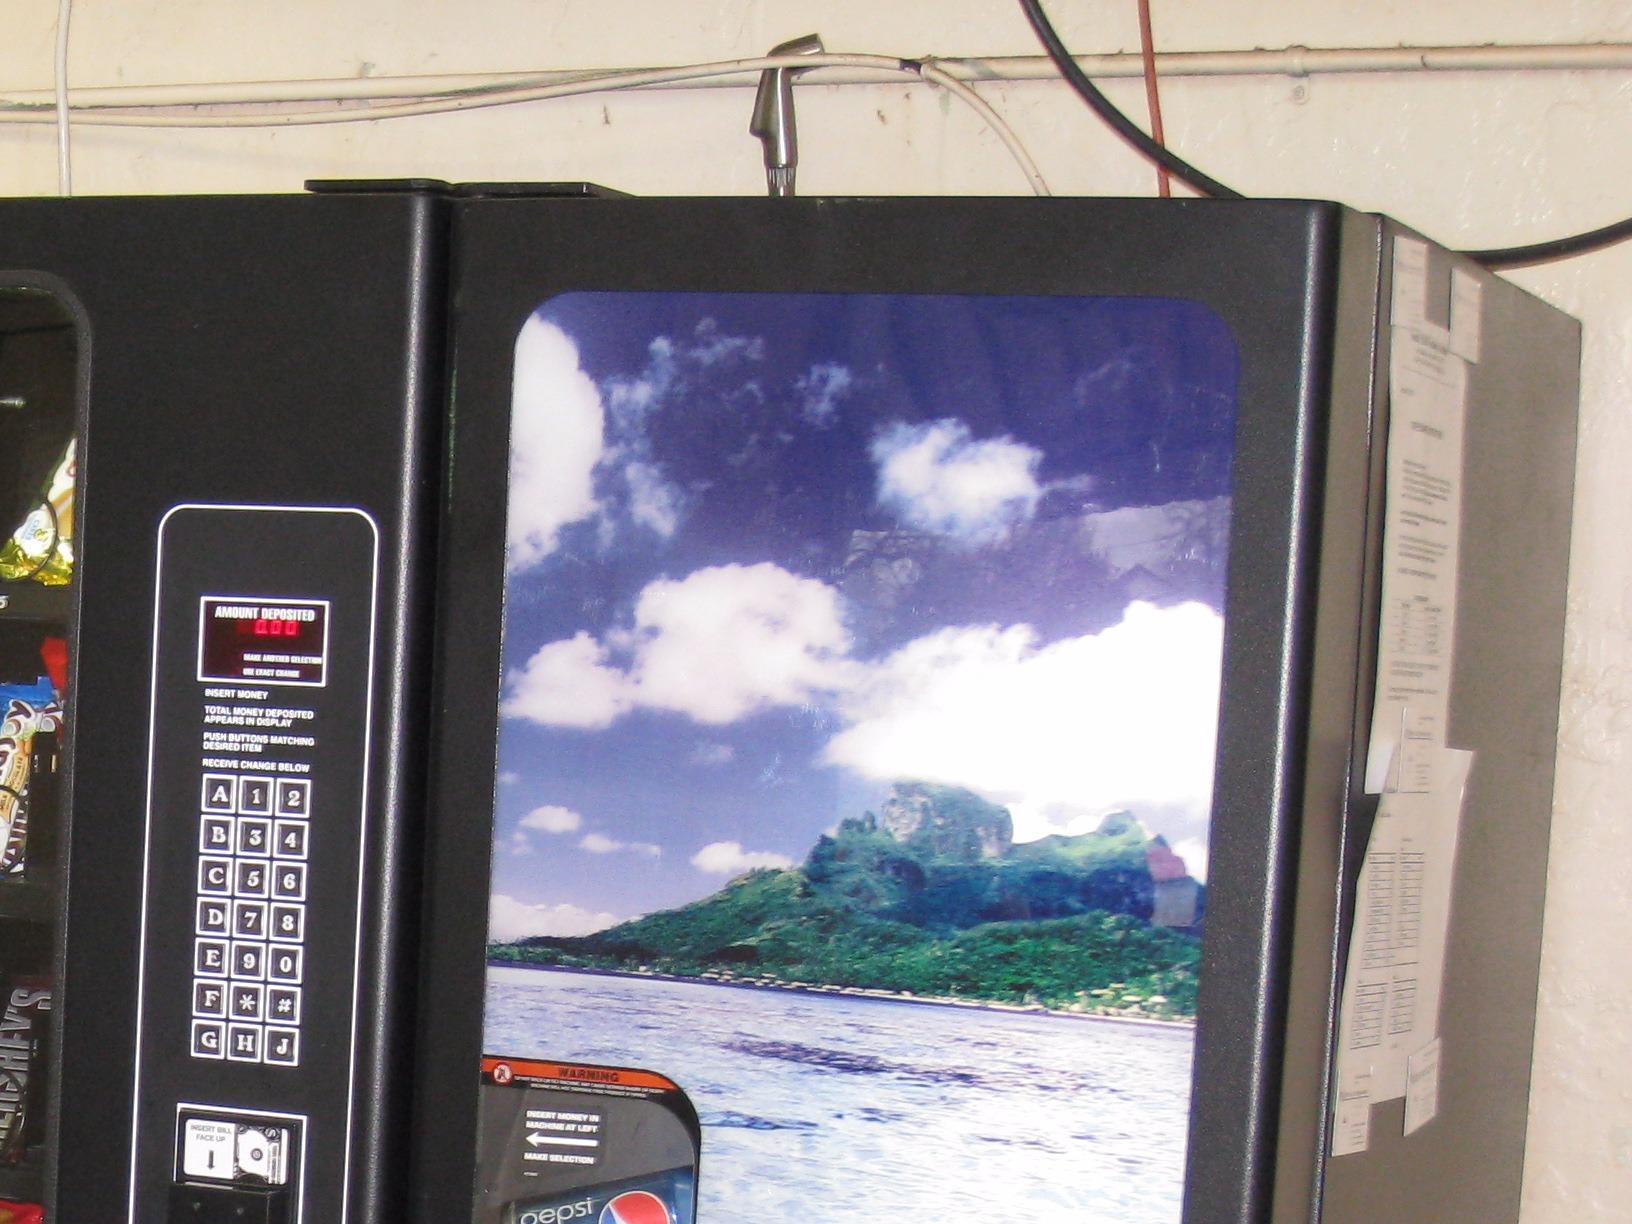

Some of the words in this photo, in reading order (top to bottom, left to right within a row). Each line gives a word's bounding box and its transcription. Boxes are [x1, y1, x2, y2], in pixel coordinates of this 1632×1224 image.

[214, 606, 259, 619] AMOUNT
[261, 607, 316, 621] DEPOSITED
[243, 653, 262, 662] MAKE
[263, 654, 290, 663] ANOTHER
[291, 655, 322, 664] SELECTION
[255, 668, 274, 677] EXACT
[275, 669, 300, 678] CHANGE
[205, 688, 235, 698] INSERT
[237, 690, 268, 699] MONEY
[204, 705, 231, 715] TOTAL
[233, 707, 264, 717] MONEY
[265, 709, 314, 719] DEPOSITED
[204, 716, 244, 726] APPEARS
[246, 717, 255, 725] IN
[256, 718, 293, 727] DISPLAY
[203, 732, 227, 741] PUSH
[228, 733, 269, 744] BUTTONS
[270, 735, 315, 746] MATCHING
[202, 742, 240, 752] DESIRED
[241, 743, 262, 752] ITEM
[202, 758, 239, 769] RECEIVE
[240, 760, 275, 771] CHANGE
[276, 762, 310, 773] BELOW
[211, 785, 229, 803] A
[251, 788, 261, 804] 1
[287, 790, 300, 807] 2
[211, 826, 226, 843] B
[248, 829, 262, 846] 3
[284, 832, 296, 848] 4
[208, 867, 224, 884] C
[247, 870, 260, 887] 5
[283, 873, 296, 890] 6
[207, 908, 223, 925] D
[244, 911, 257, 928] 7
[281, 914, 294, 931] 8
[204, 949, 221, 967] E
[242, 953, 256, 969] 9
[279, 956, 292, 973] 0
[204, 990, 220, 1007] F
[201, 1031, 217, 1048] G
[236, 1034, 254, 1052] H
[276, 1038, 289, 1055] J
[559, 1067, 619, 1083] WARNING
[526, 1110, 556, 1120] INSERT
[557, 1112, 587, 1122] MONEY
[589, 1114, 600, 1123] IN
[190, 1123, 217, 1134] INSERT
[217, 1125, 233, 1135] BILL
[525, 1121, 565, 1132] MACHINE
[565, 1122, 575, 1131] AT
[577, 1123, 599, 1134] LEFT
[195, 1132, 215, 1142] FACE
[215, 1134, 226, 1143] UP
[524, 1152, 548, 1162] MAKE
[549, 1154, 595, 1165] SELECTION
